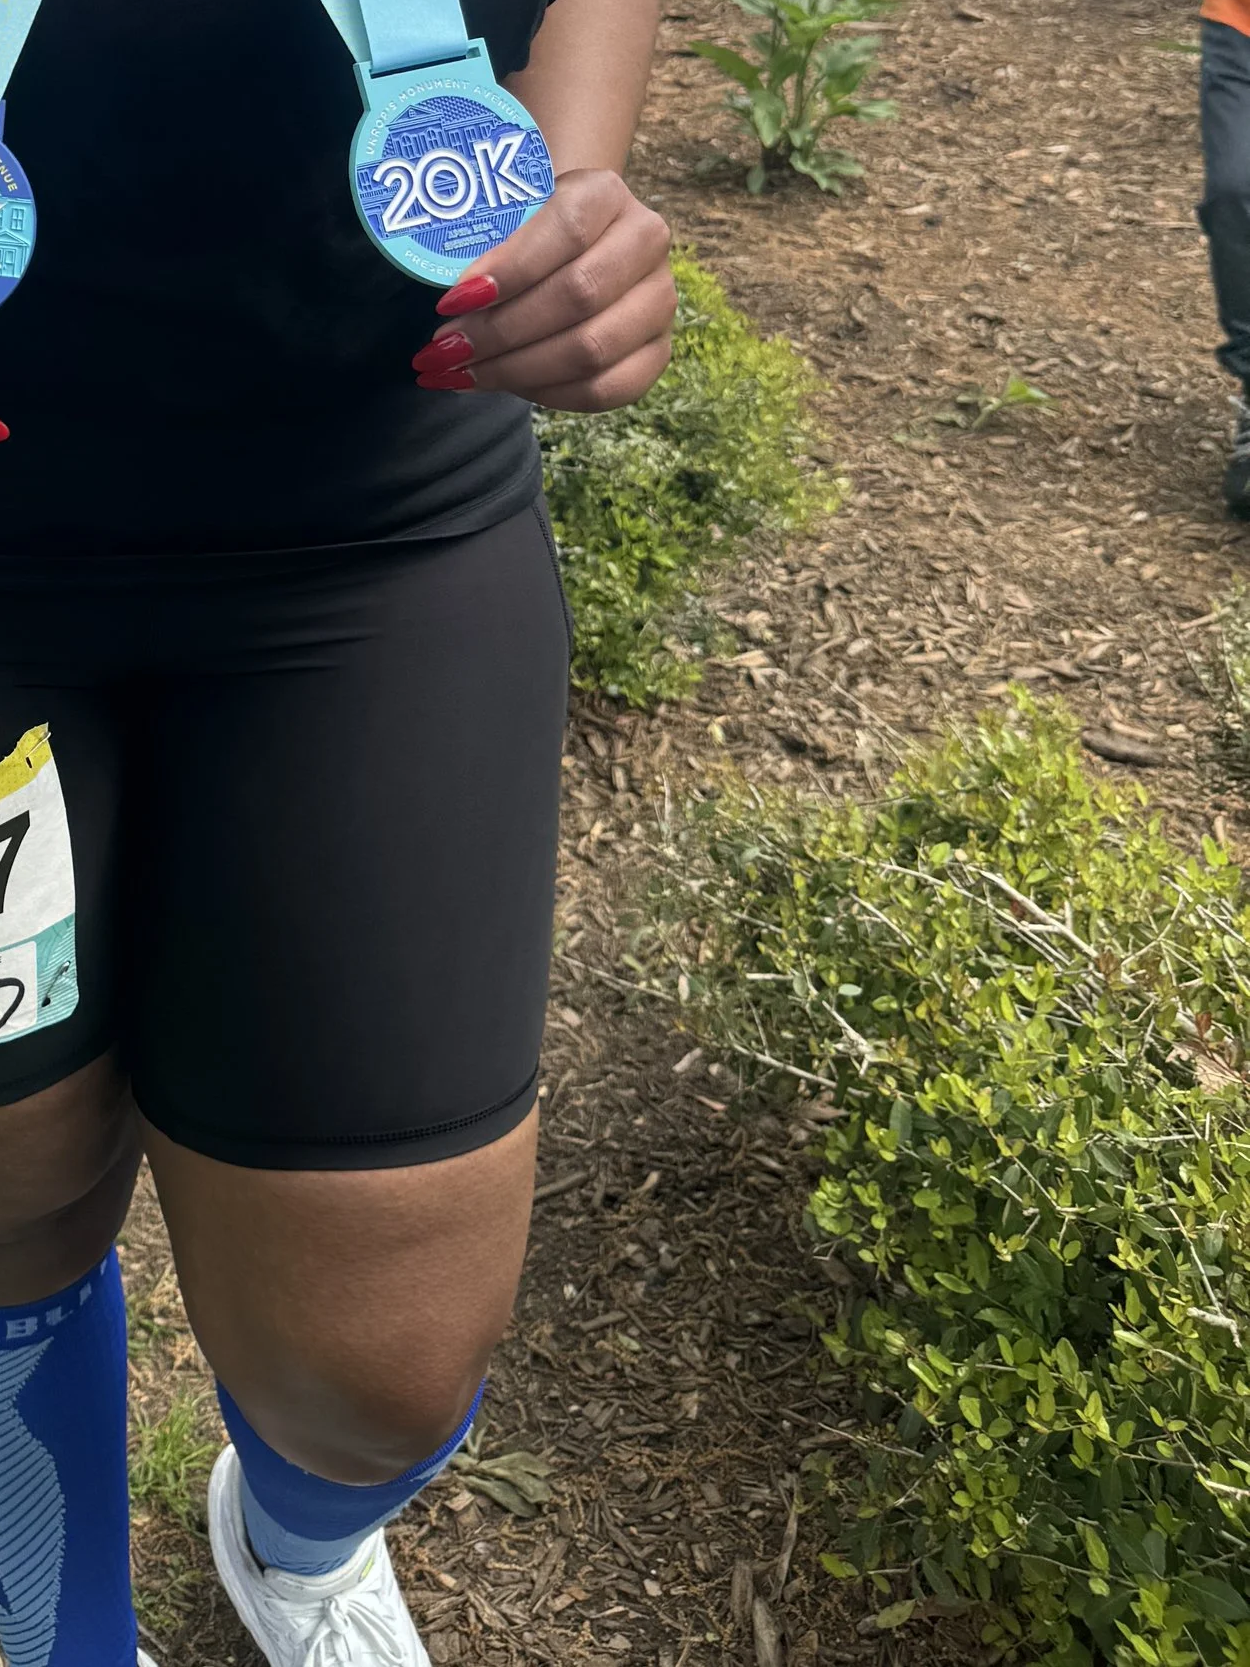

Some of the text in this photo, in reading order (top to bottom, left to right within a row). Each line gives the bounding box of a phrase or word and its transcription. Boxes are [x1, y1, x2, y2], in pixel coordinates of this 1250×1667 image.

[365, 79, 521, 156] UKROP'S MONUMENT AVENUE
[372, 131, 528, 234] 20K
